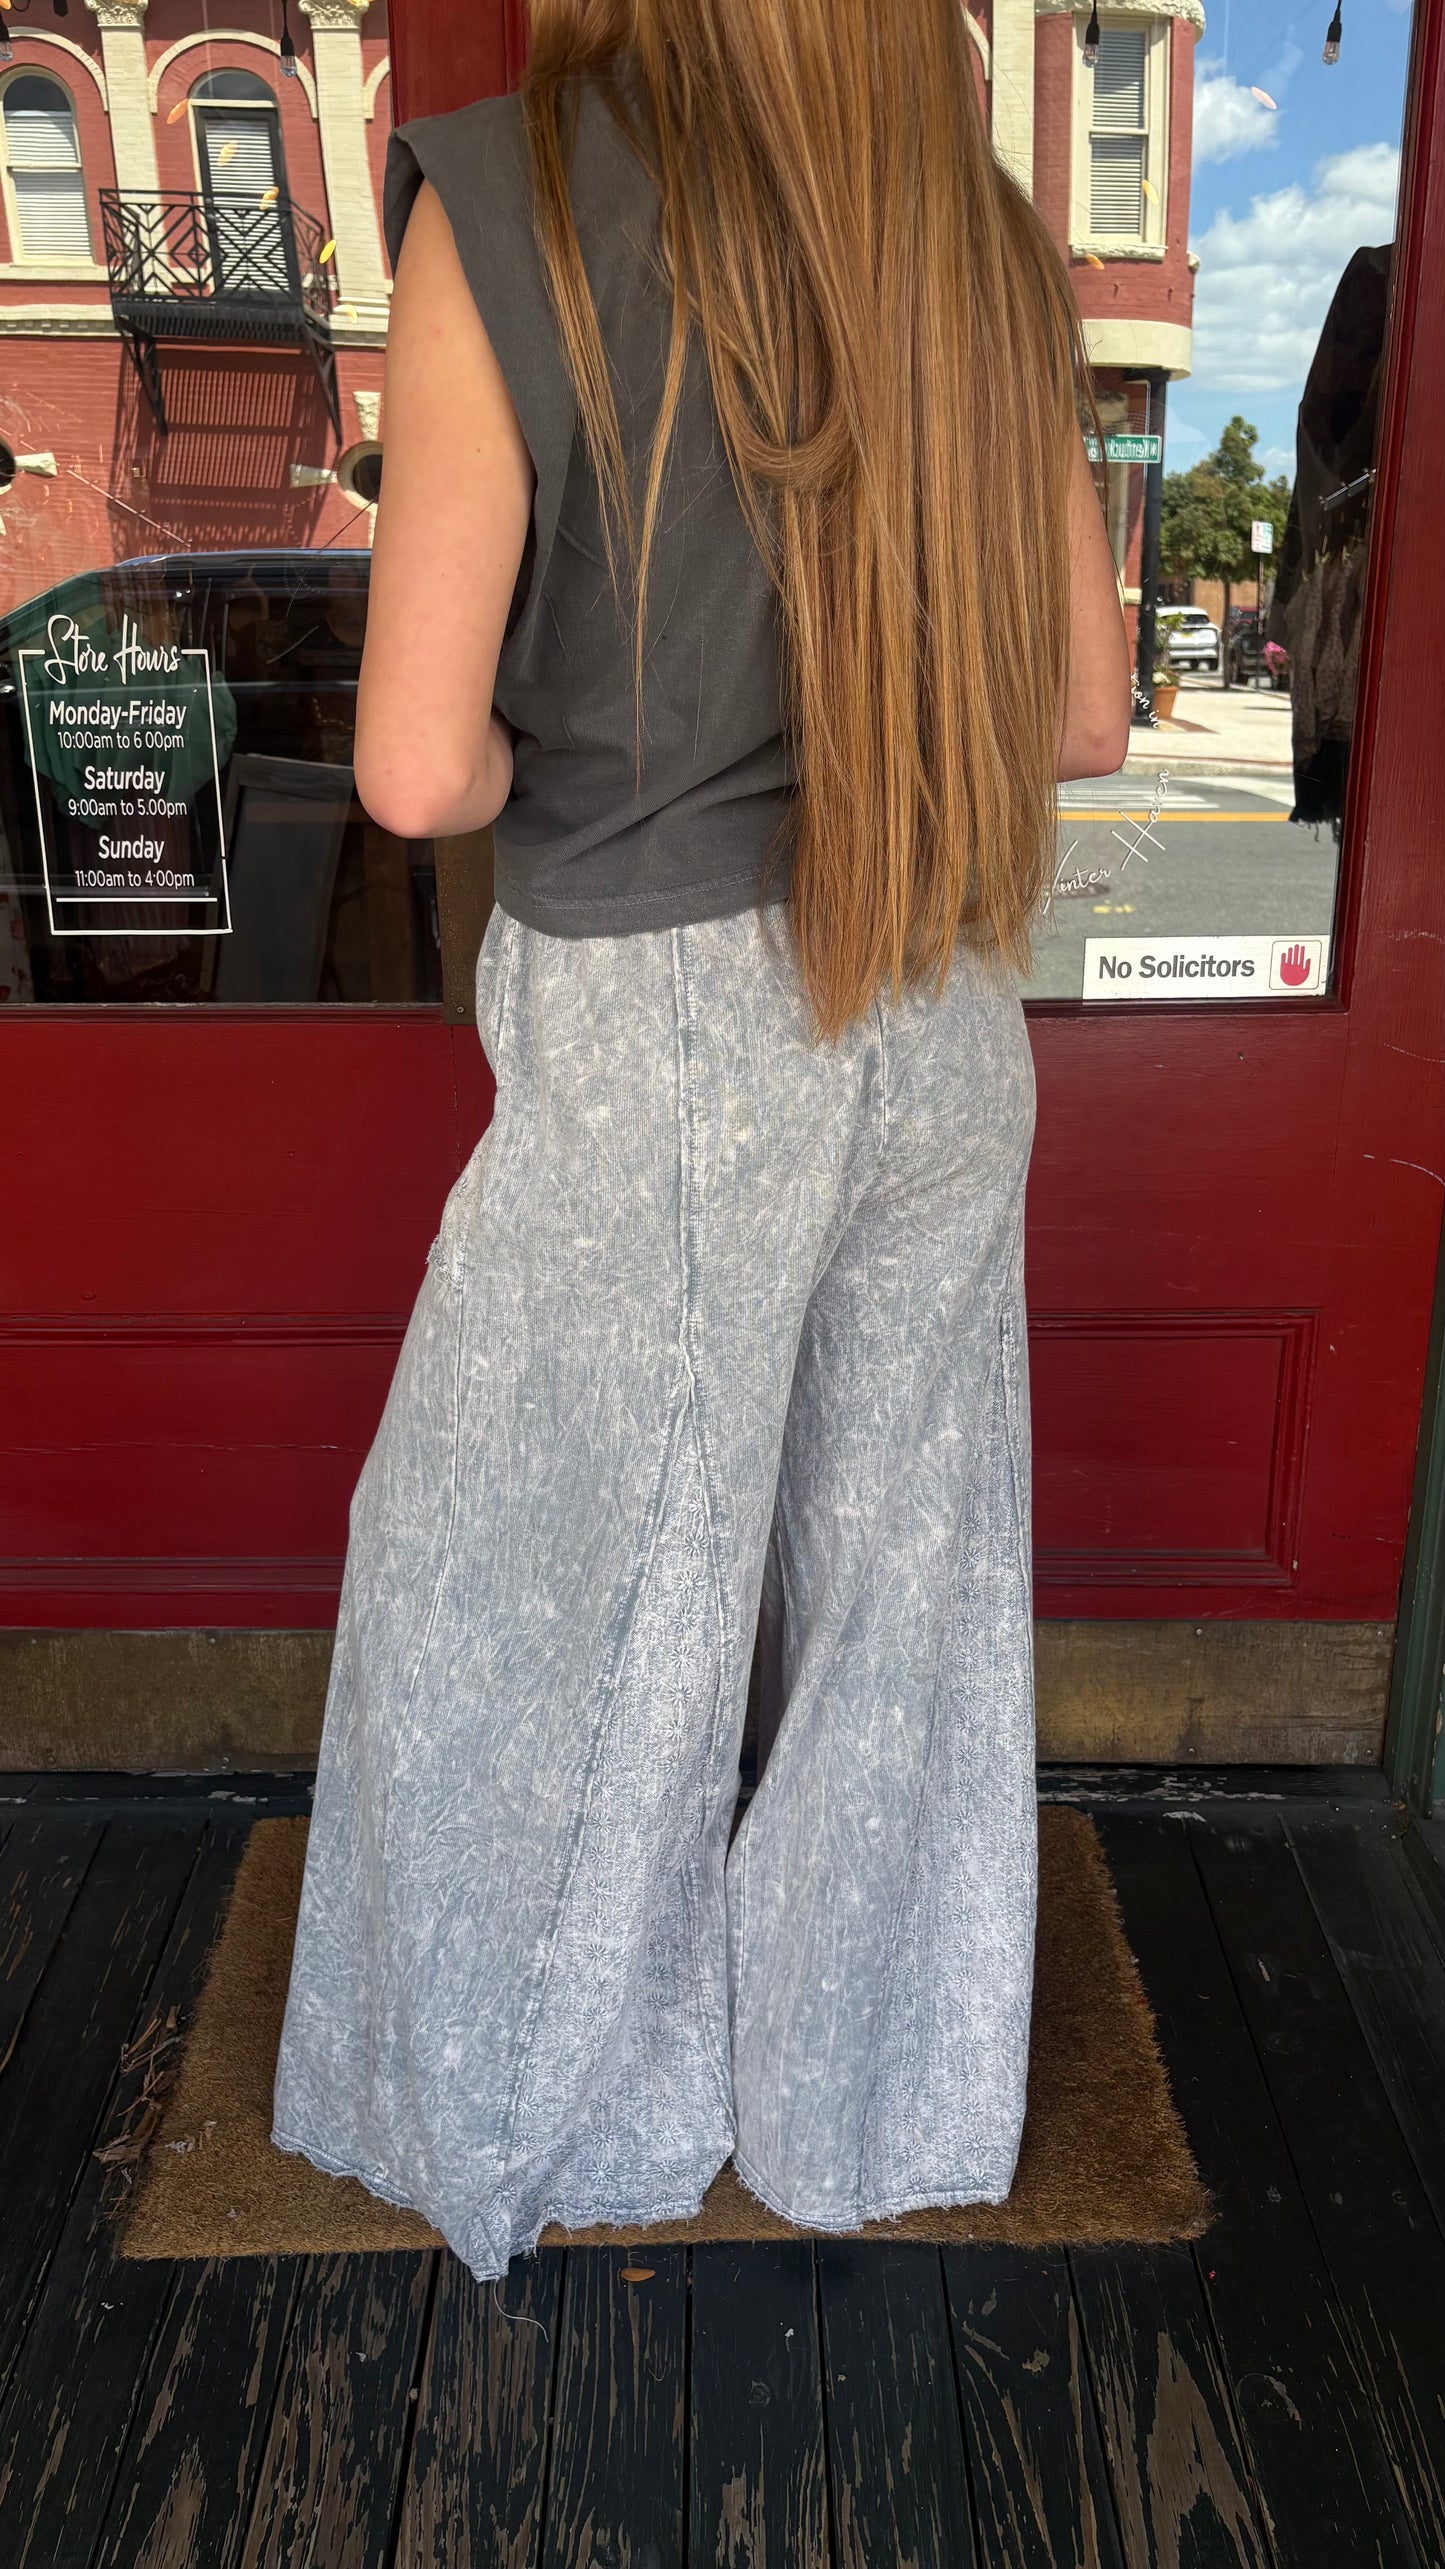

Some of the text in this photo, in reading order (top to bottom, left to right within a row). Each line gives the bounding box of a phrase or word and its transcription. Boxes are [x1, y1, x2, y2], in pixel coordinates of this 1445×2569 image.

[43, 613, 181, 685] Store Hours
[49, 699, 187, 730] Monday-Friday
[1148, 709, 1161, 729] in
[57, 731, 114, 749] 10:00am
[116, 731, 131, 749] to
[84, 764, 166, 795] Saturday
[68, 798, 118, 816] 9:00am
[120, 799, 135, 816] to
[1110, 769, 1170, 871] Haven
[98, 834, 165, 864] Sunday
[74, 870, 125, 888] 11:00am
[127, 870, 142, 888] to
[1099, 954, 1256, 979] No Solicitors
